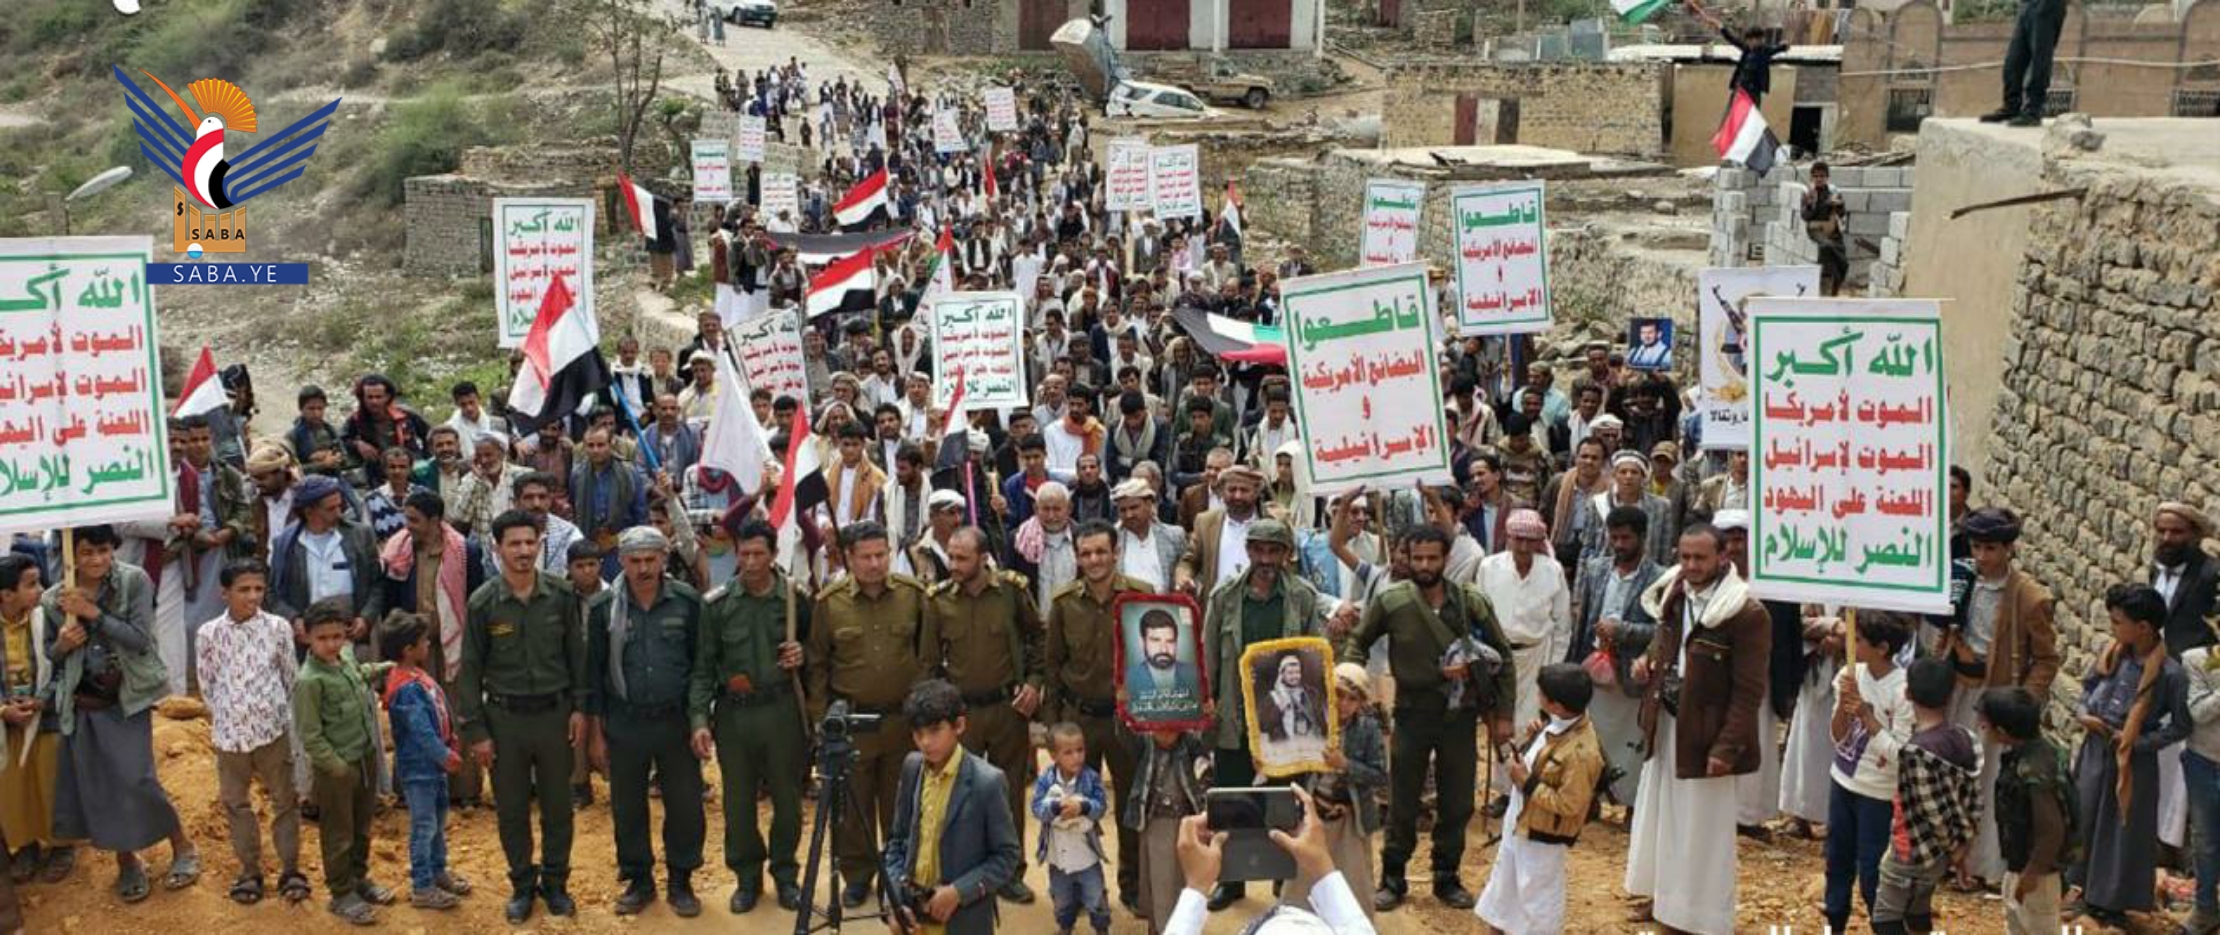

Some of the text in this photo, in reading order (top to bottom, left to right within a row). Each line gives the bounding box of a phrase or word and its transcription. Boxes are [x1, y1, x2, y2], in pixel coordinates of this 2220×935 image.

[1460, 200, 1537, 233] قاطعوا
[0, 264, 141, 311] الله أك
[71, 324, 144, 357] الموت
[1294, 294, 1420, 352] قاطعوا
[1302, 349, 1426, 396] البضائع الأمريكية
[1765, 325, 1933, 388] الله أكبر
[75, 367, 147, 399] الموت
[97, 409, 150, 437] اللعنة
[1362, 395, 1371, 419] و
[1765, 388, 1932, 429] الموت لأمريكا
[53, 413, 86, 446] على
[1315, 423, 1436, 467] الإسرائيلية
[0, 445, 154, 501] النصر للإسلا
[1765, 437, 1932, 476] الموت لإسرائيل
[1765, 481, 1932, 519] اللعنة على اليهود
[1765, 521, 1931, 573] النصر للإسلام
